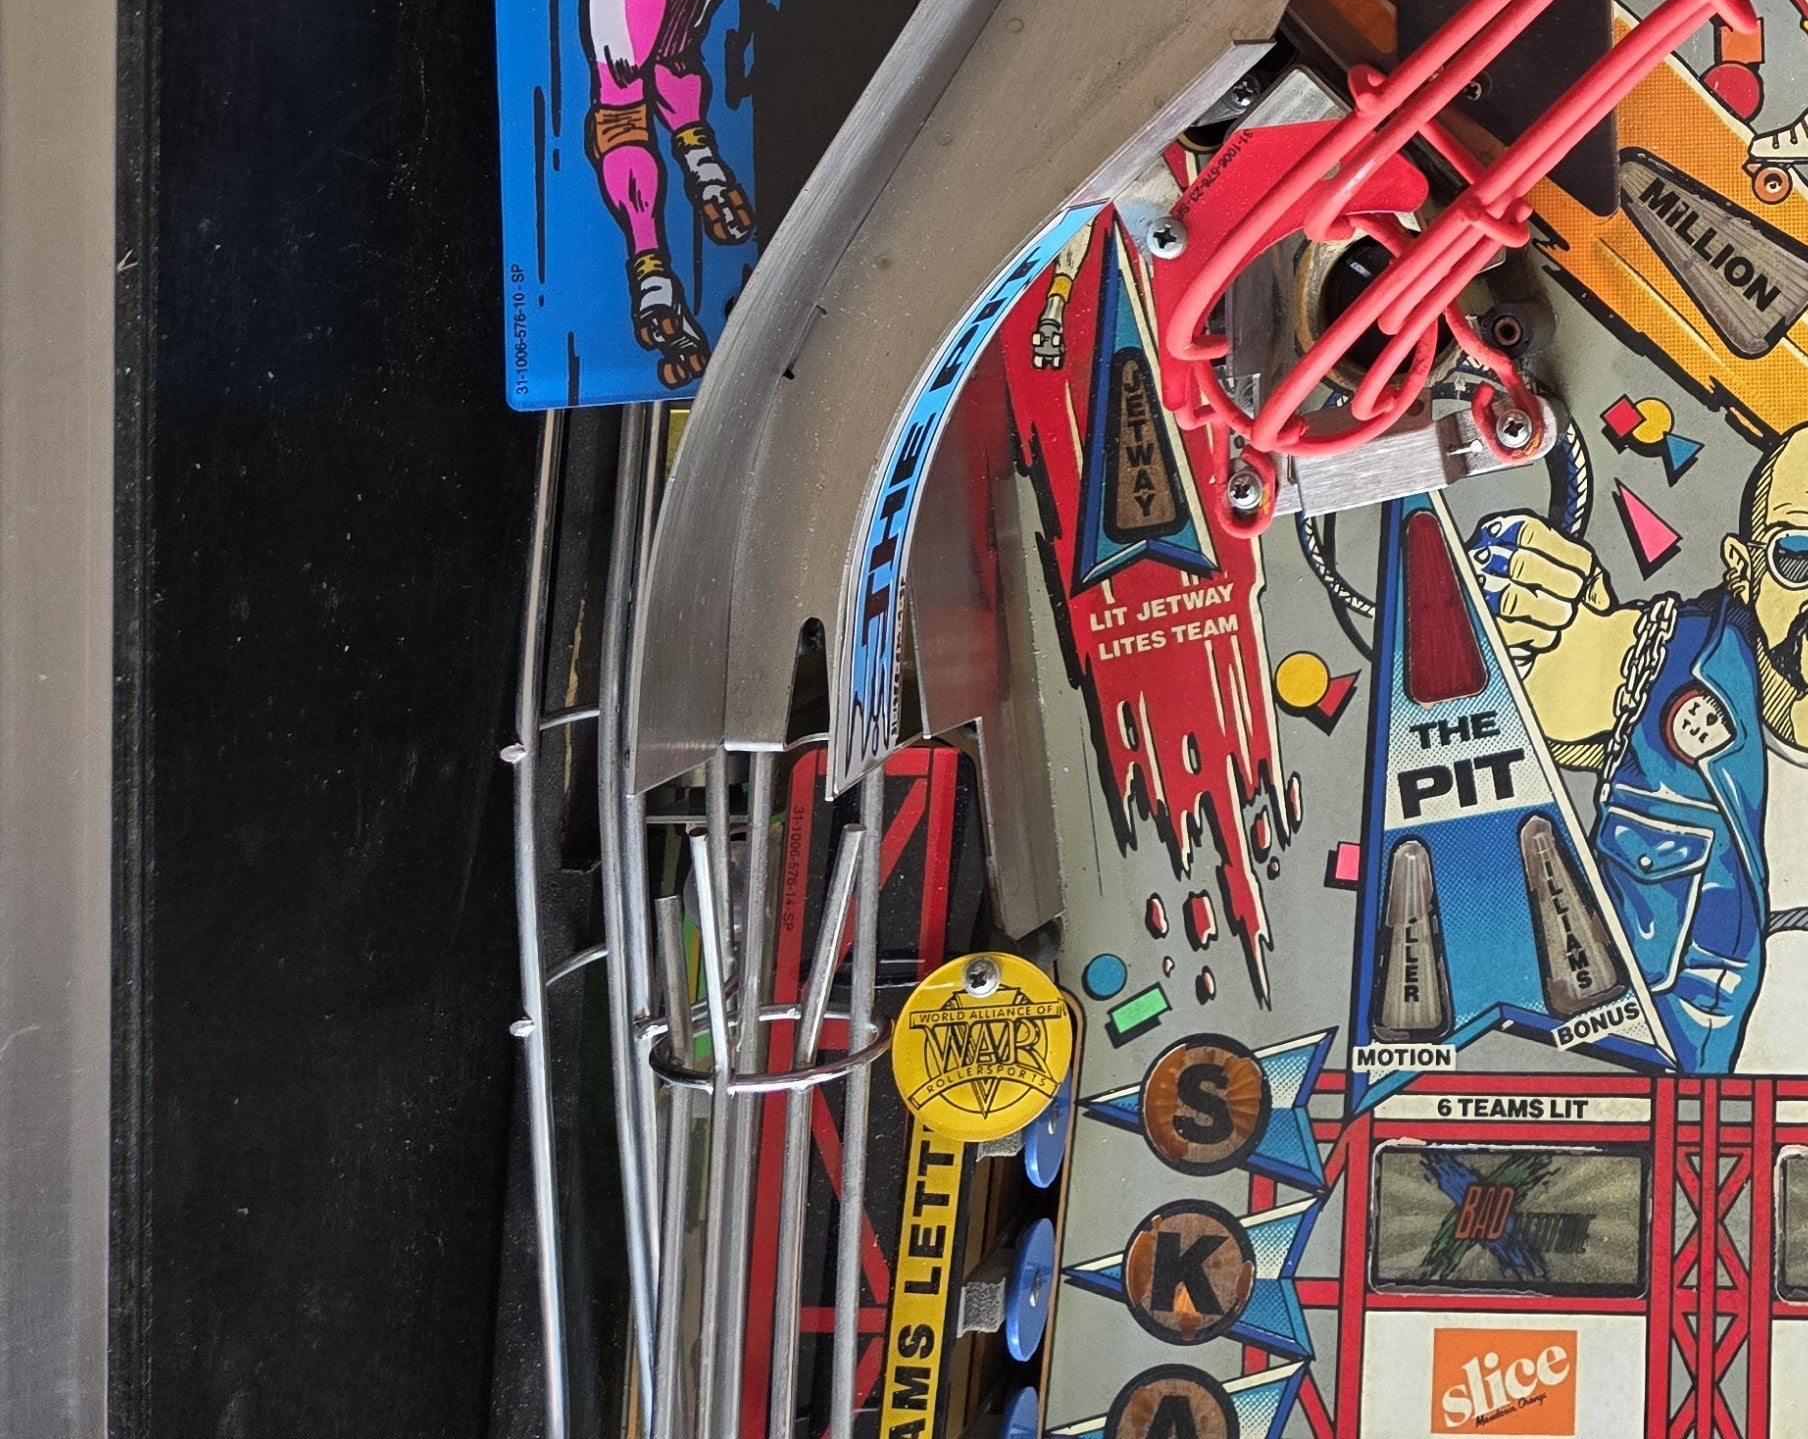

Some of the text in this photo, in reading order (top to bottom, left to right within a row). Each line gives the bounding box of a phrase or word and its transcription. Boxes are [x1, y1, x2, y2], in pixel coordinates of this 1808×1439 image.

[1640, 177, 1781, 316] MILLION
[928, 246, 1042, 393] PIT
[1122, 369, 1157, 518] JETWAY
[860, 411, 937, 647] THE
[1089, 582, 1235, 633] LIT JETWAY
[1098, 614, 1240, 662] LITES TEAM
[1409, 709, 1501, 751] THE
[1396, 747, 1526, 820] PIT
[919, 1003, 1053, 1024] WORLD ALLIANCE OF
[1557, 1000, 1642, 1047] BONUS
[923, 1018, 1050, 1081] WAR
[926, 1065, 1047, 1094] ROLLERSPORTS
[1356, 1047, 1453, 1068] MOTION
[1172, 1063, 1231, 1146] S
[1437, 1097, 1590, 1120] 6 TEAMS LIT
[905, 1126, 957, 1297] LETT
[1454, 1184, 1516, 1241] BAD
[1151, 1231, 1229, 1316] K
[1440, 1344, 1571, 1430] slice
